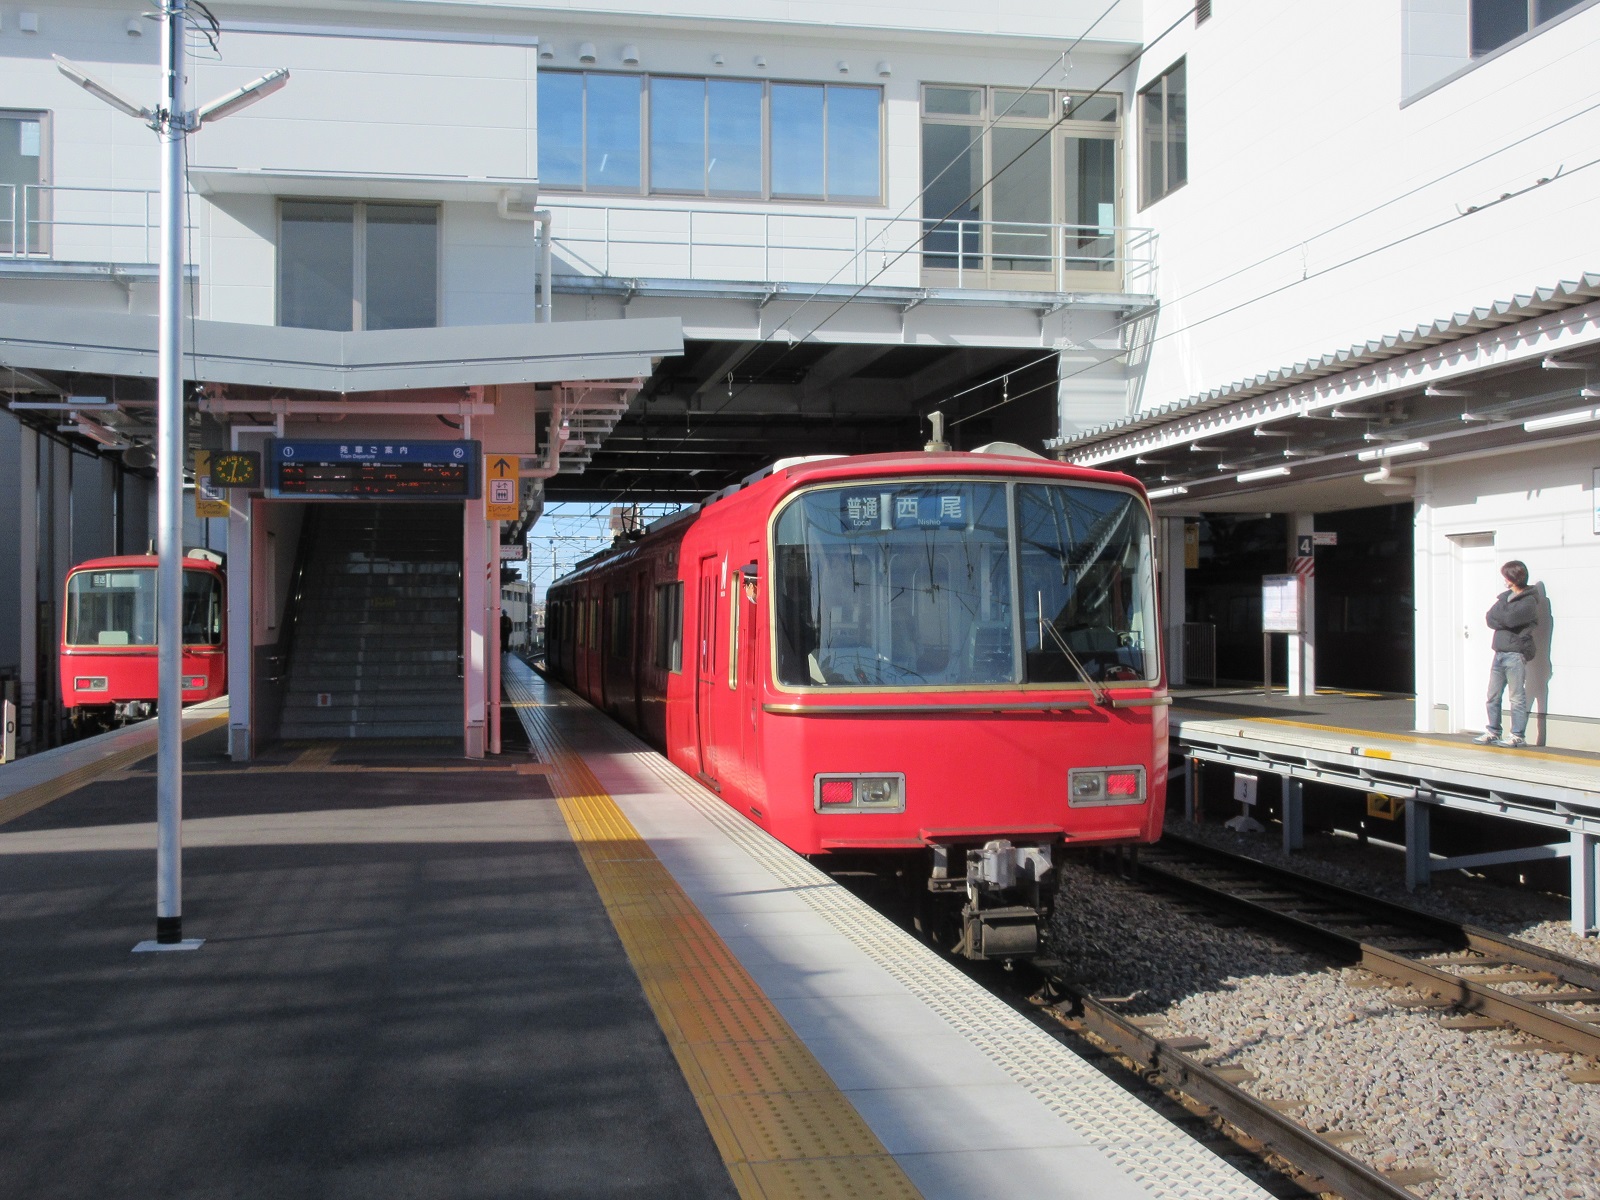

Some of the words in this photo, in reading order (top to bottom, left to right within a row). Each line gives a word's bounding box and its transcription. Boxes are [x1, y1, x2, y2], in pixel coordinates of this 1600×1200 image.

[340, 446, 408, 454] 発車ご案内
[847, 497, 878, 519] 普通
[896, 496, 962, 519] 西尾
[1300, 539, 1310, 553] 4
